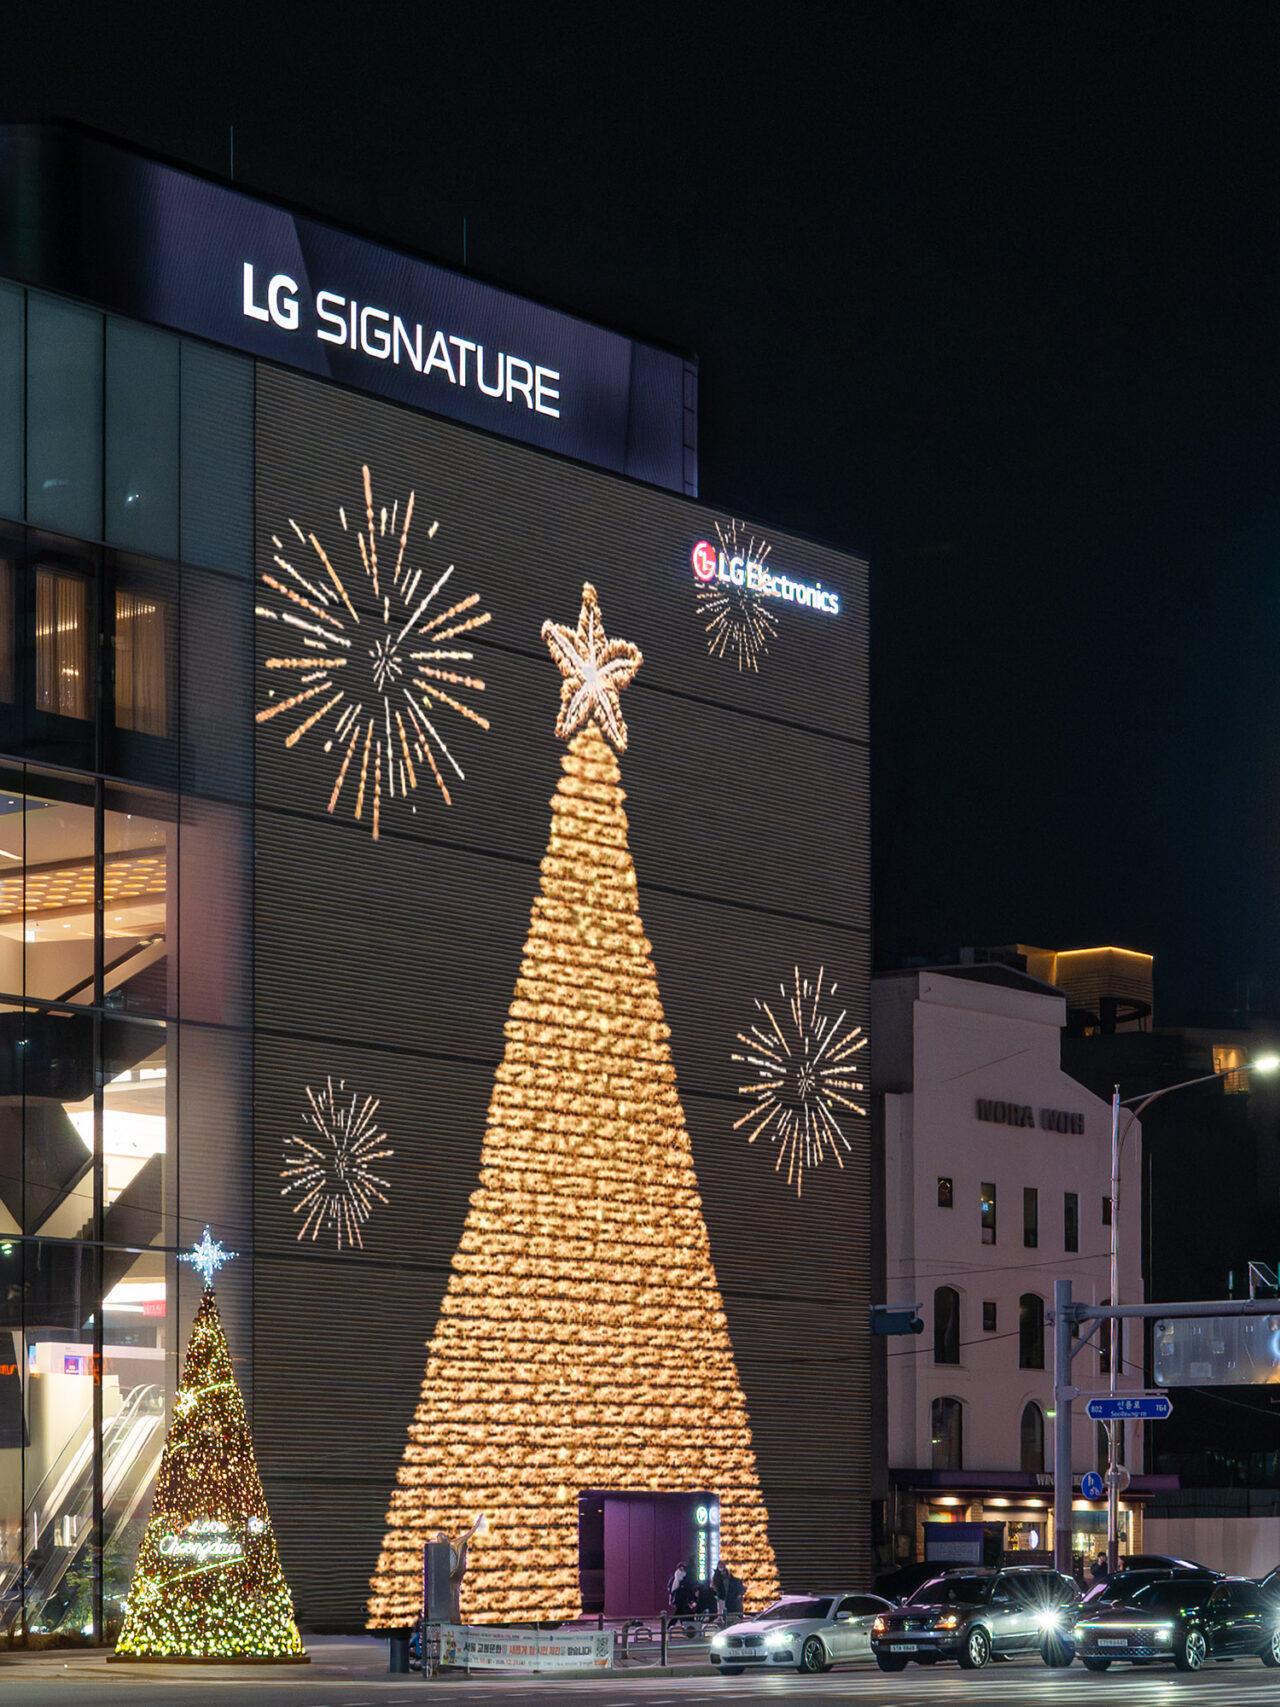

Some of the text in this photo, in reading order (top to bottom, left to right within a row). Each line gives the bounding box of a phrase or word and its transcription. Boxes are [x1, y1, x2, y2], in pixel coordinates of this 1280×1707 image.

[243, 262, 560, 419] LG SIGNATURE
[719, 552, 840, 615] LG Electronics
